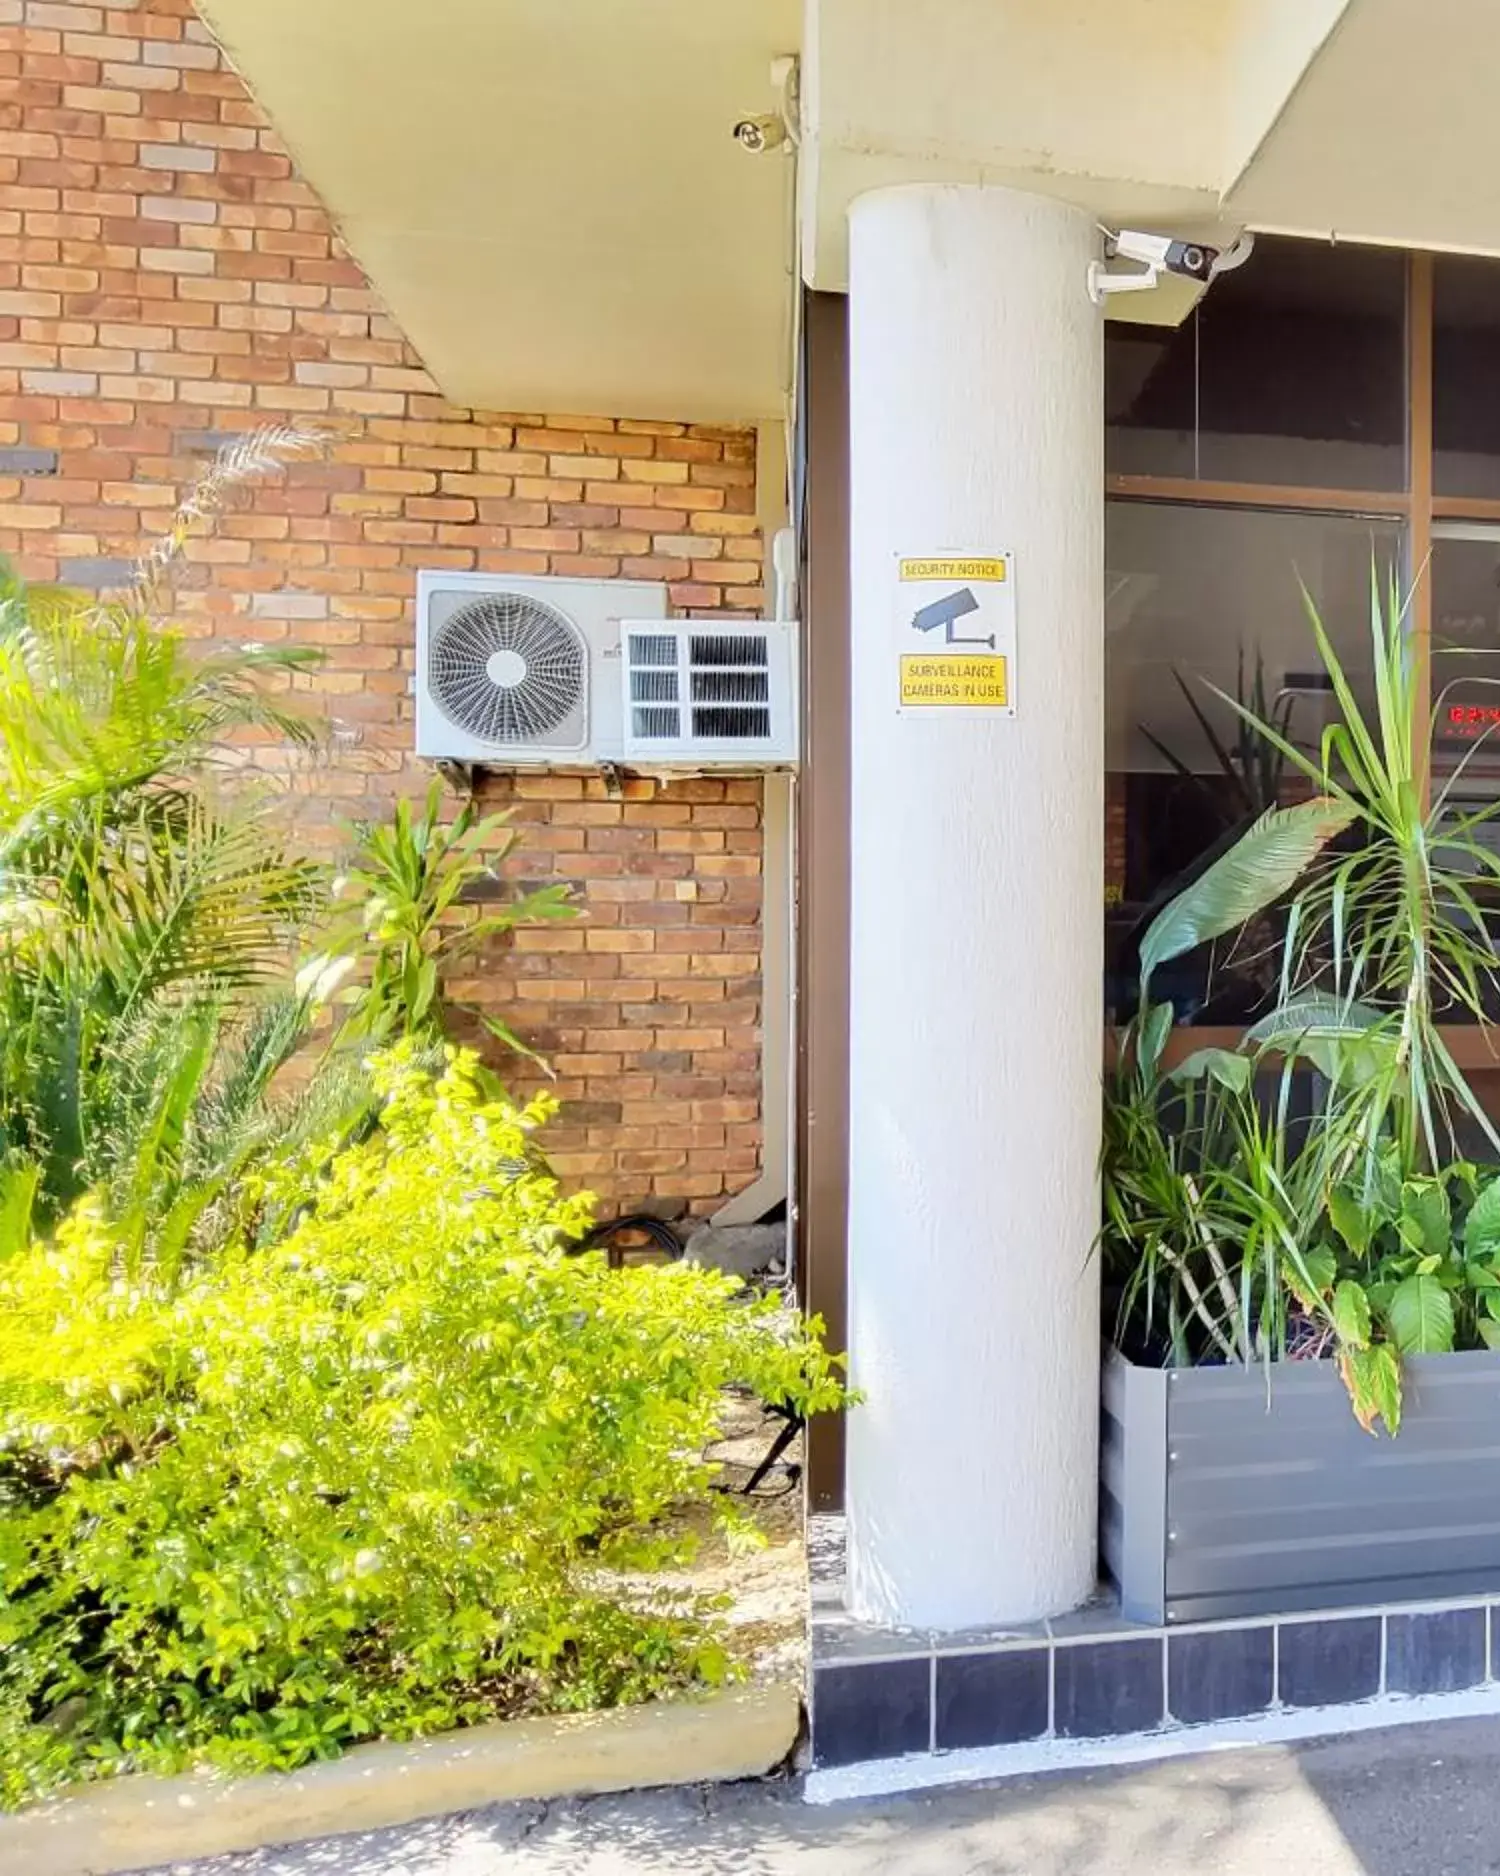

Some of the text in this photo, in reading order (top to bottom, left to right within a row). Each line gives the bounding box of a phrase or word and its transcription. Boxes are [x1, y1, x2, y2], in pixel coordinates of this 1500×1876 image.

[904, 563, 999, 577] SECURITY NOTICE
[908, 663, 997, 678] SURVEILLANCE
[903, 683, 1002, 698] CAMERAS IN USE
